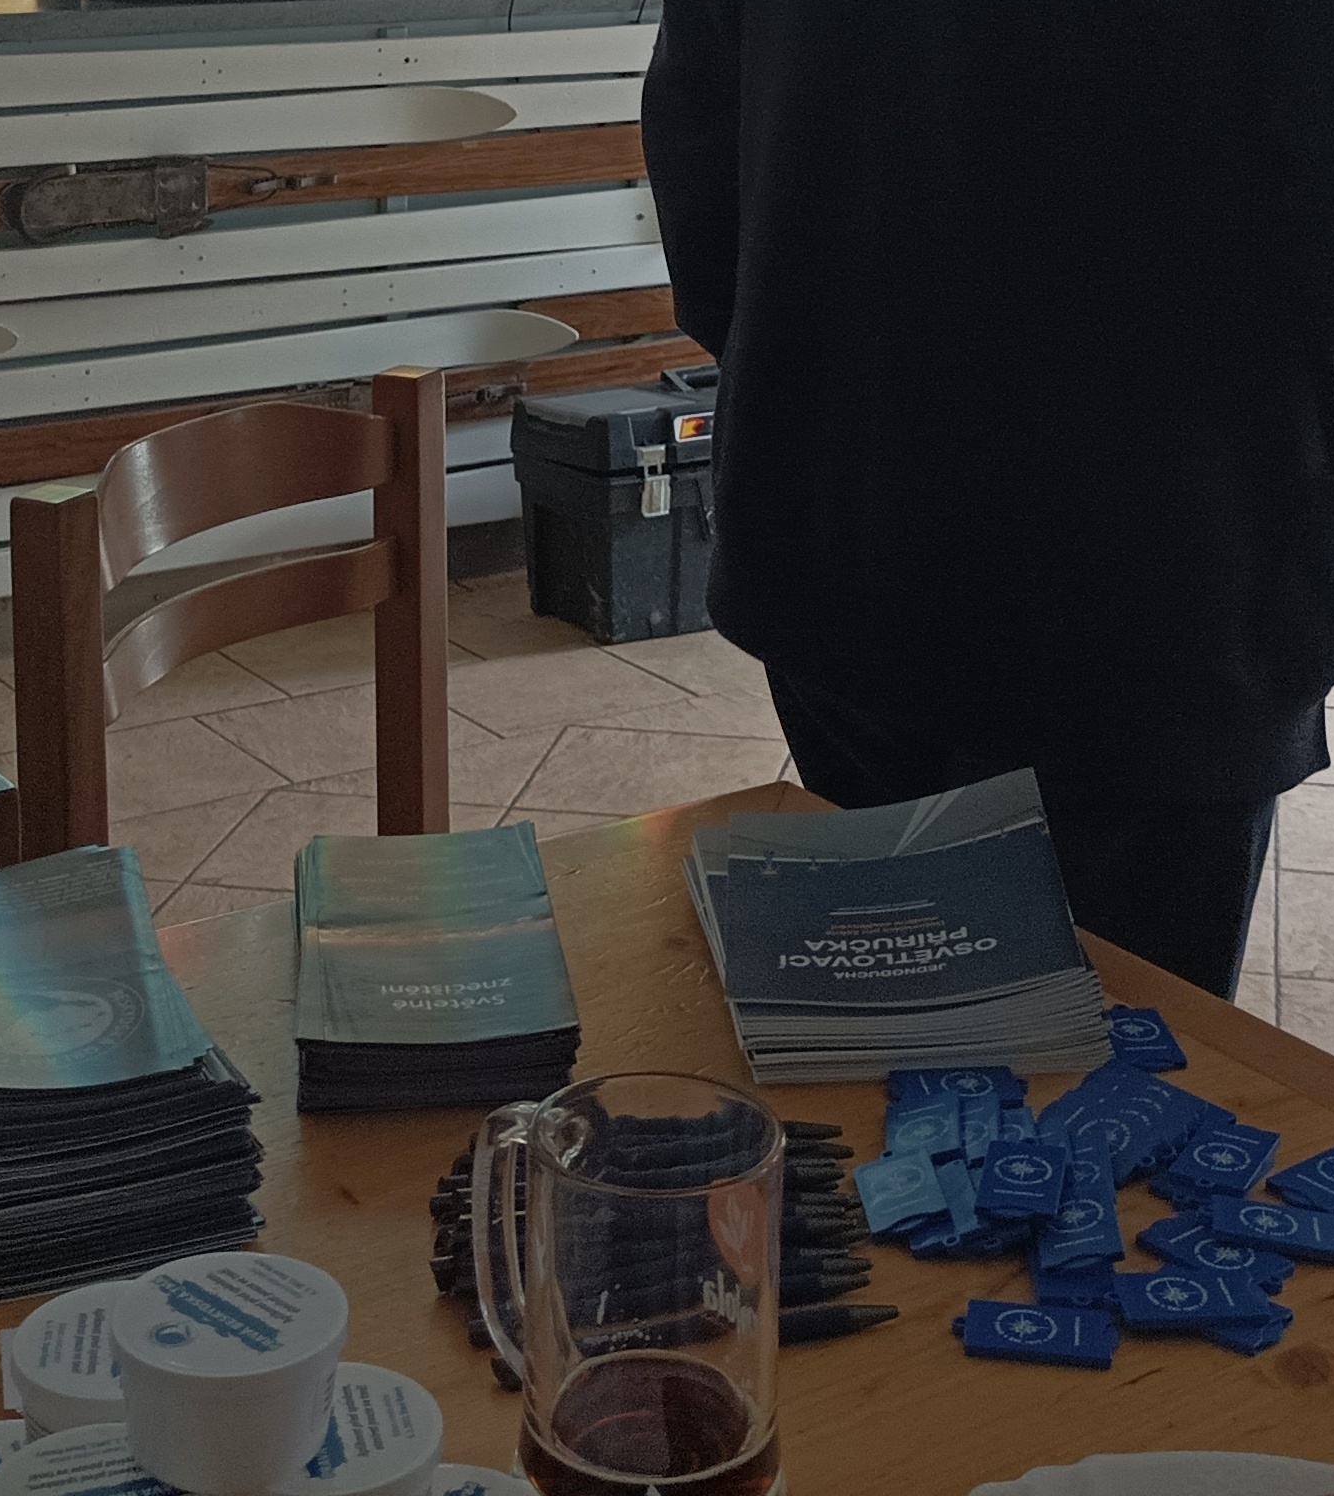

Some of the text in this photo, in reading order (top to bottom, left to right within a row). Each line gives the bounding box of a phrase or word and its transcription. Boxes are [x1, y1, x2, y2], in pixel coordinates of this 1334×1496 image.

[803, 926, 968, 952] PŘÍRUČKA
[777, 936, 998, 969] OSVĚTLOVACÍ
[834, 962, 947, 980] JEDNODUCHÁ
[391, 993, 505, 1012] Světelné
